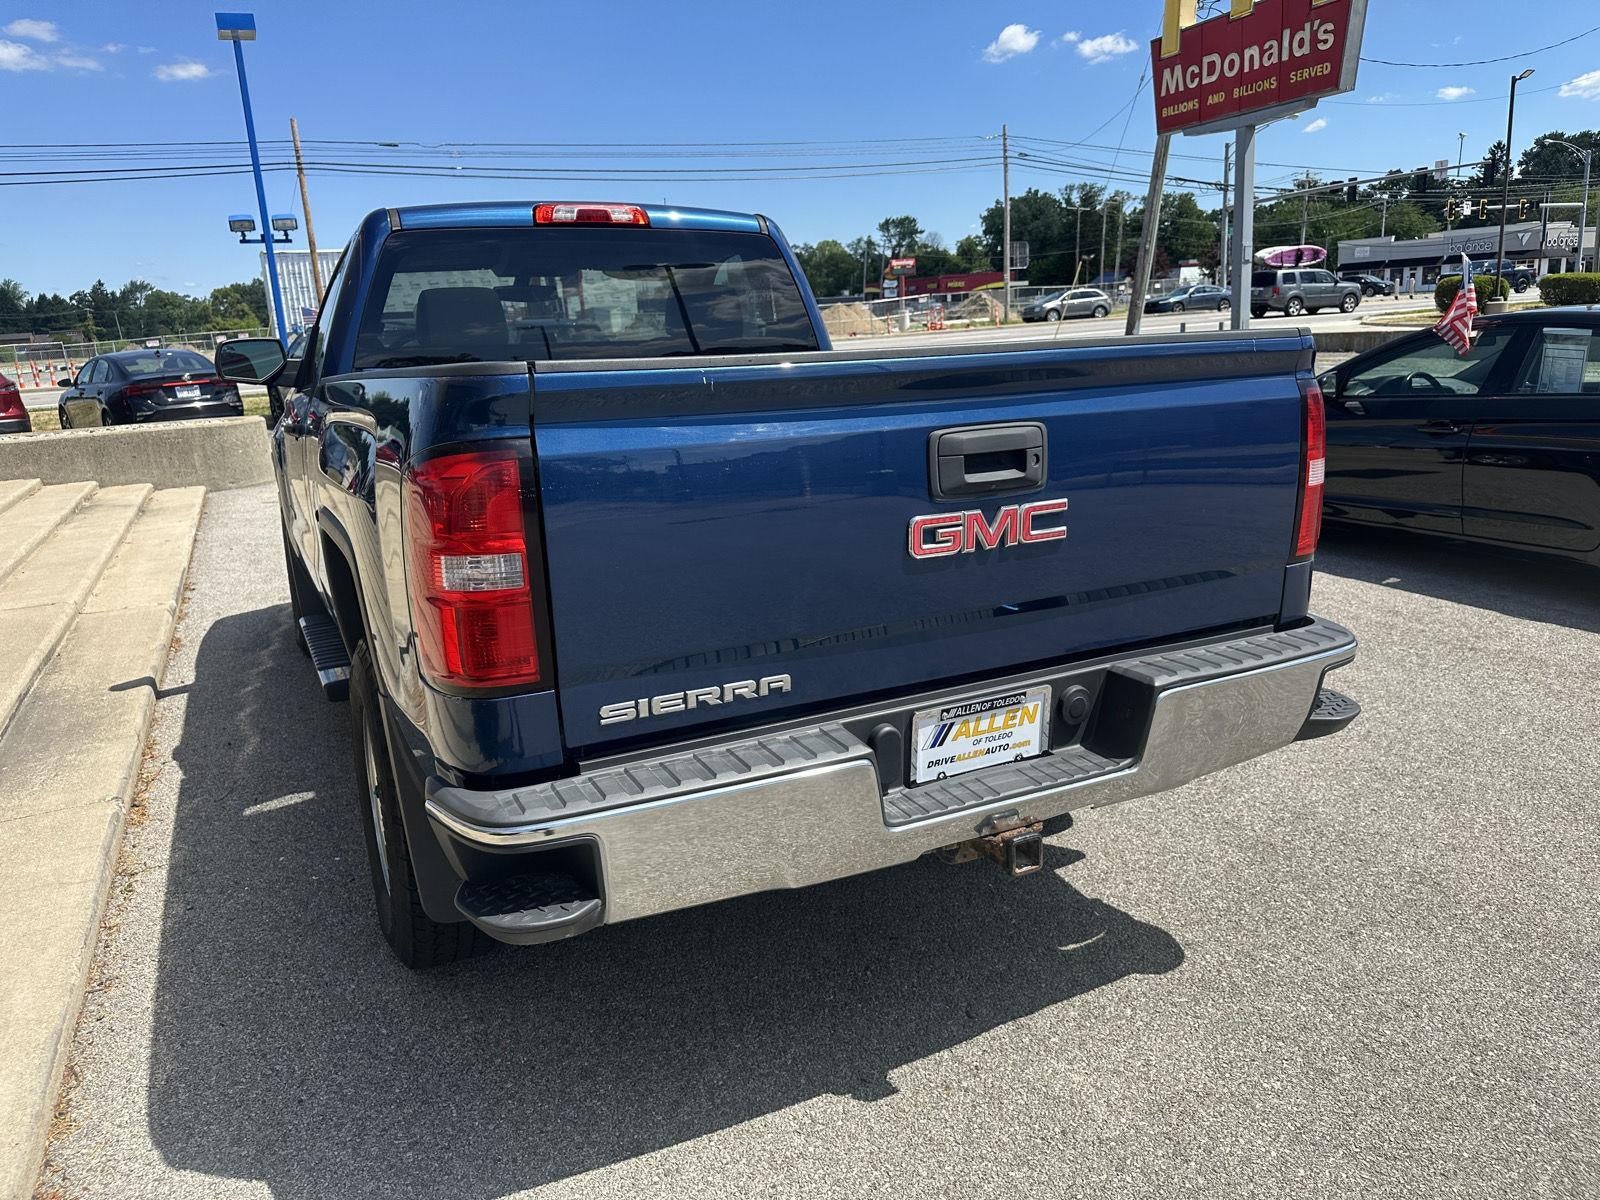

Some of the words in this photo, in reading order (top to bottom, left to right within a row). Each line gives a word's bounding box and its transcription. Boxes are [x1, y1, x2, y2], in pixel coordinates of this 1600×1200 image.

[1160, 19, 1335, 97] McDonald's
[1162, 98, 1199, 117] BILLIONS
[1207, 91, 1225, 105] AND
[1233, 77, 1277, 98] BILLIONS
[1289, 62, 1331, 82] SERVED
[1450, 238, 1493, 253] balance
[908, 498, 1069, 560] GMC
[599, 673, 792, 726] SIERRA
[951, 703, 1039, 741] ALLEN
[956, 704, 981, 716] ALLEN
[981, 701, 992, 710] OF
[993, 696, 1020, 708] TOLEDO
[972, 737, 984, 746] OF
[984, 731, 1013, 743] TOLEDO
